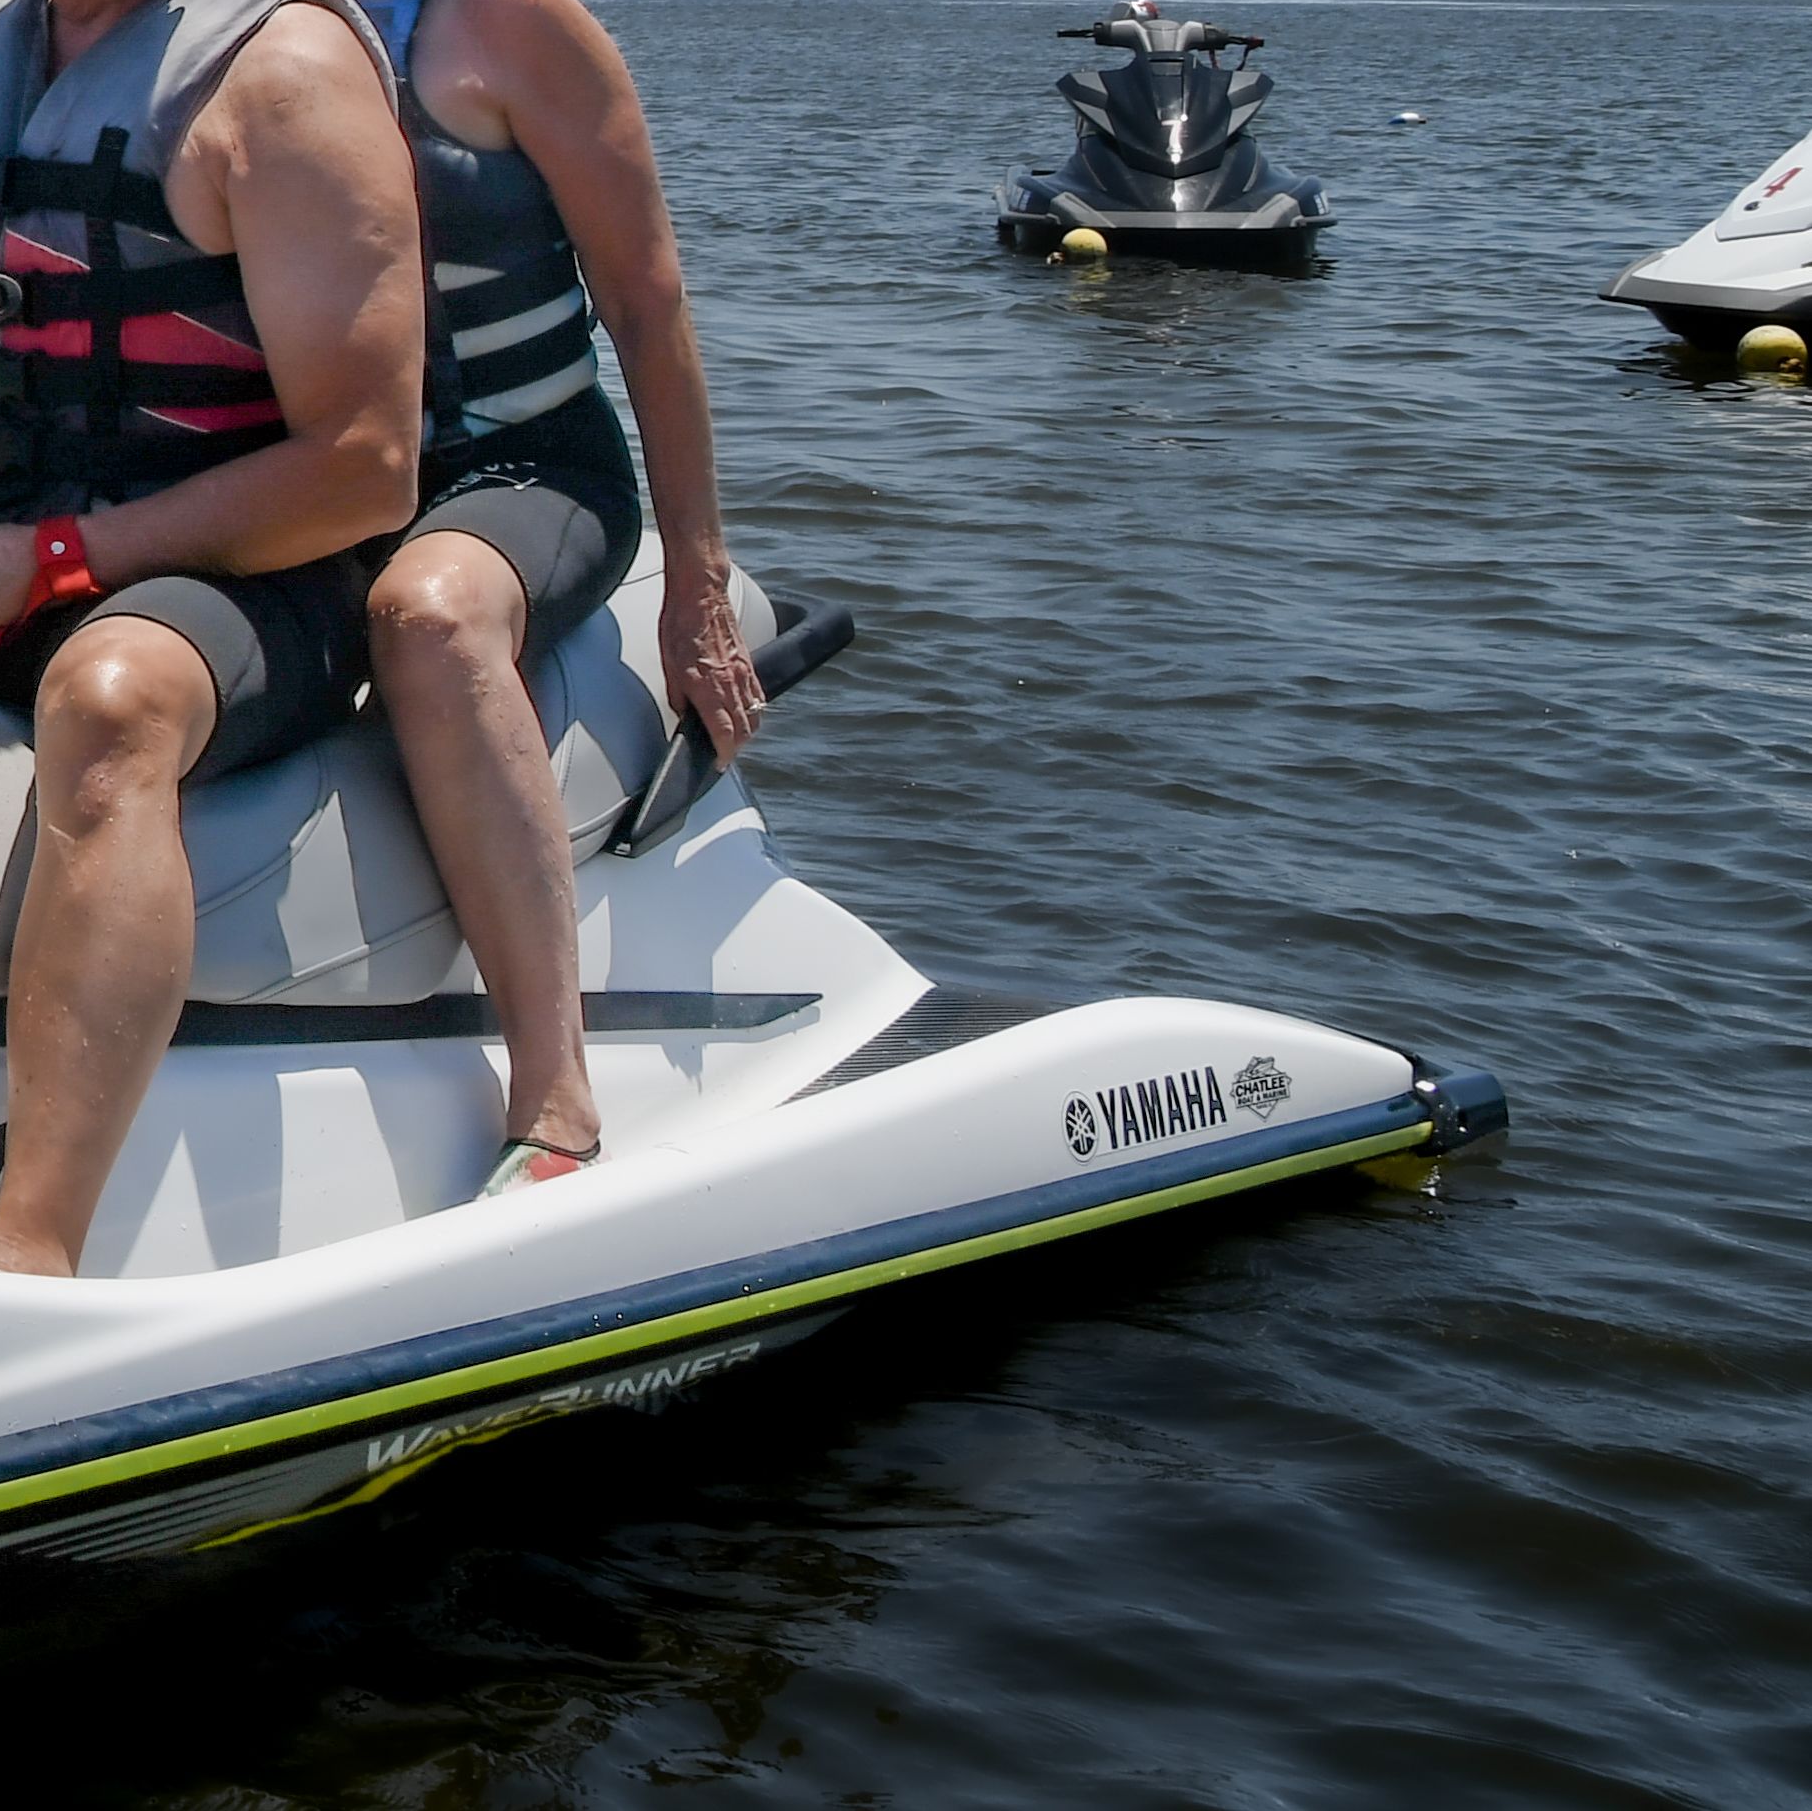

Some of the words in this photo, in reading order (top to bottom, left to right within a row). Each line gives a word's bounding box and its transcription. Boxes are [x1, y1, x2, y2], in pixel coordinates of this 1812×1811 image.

[1763, 167, 1803, 198] 4
[1235, 1075, 1286, 1097] CHATLEE
[1096, 1065, 1228, 1150] YAMAHA
[1237, 1094, 1254, 1105] BOAT
